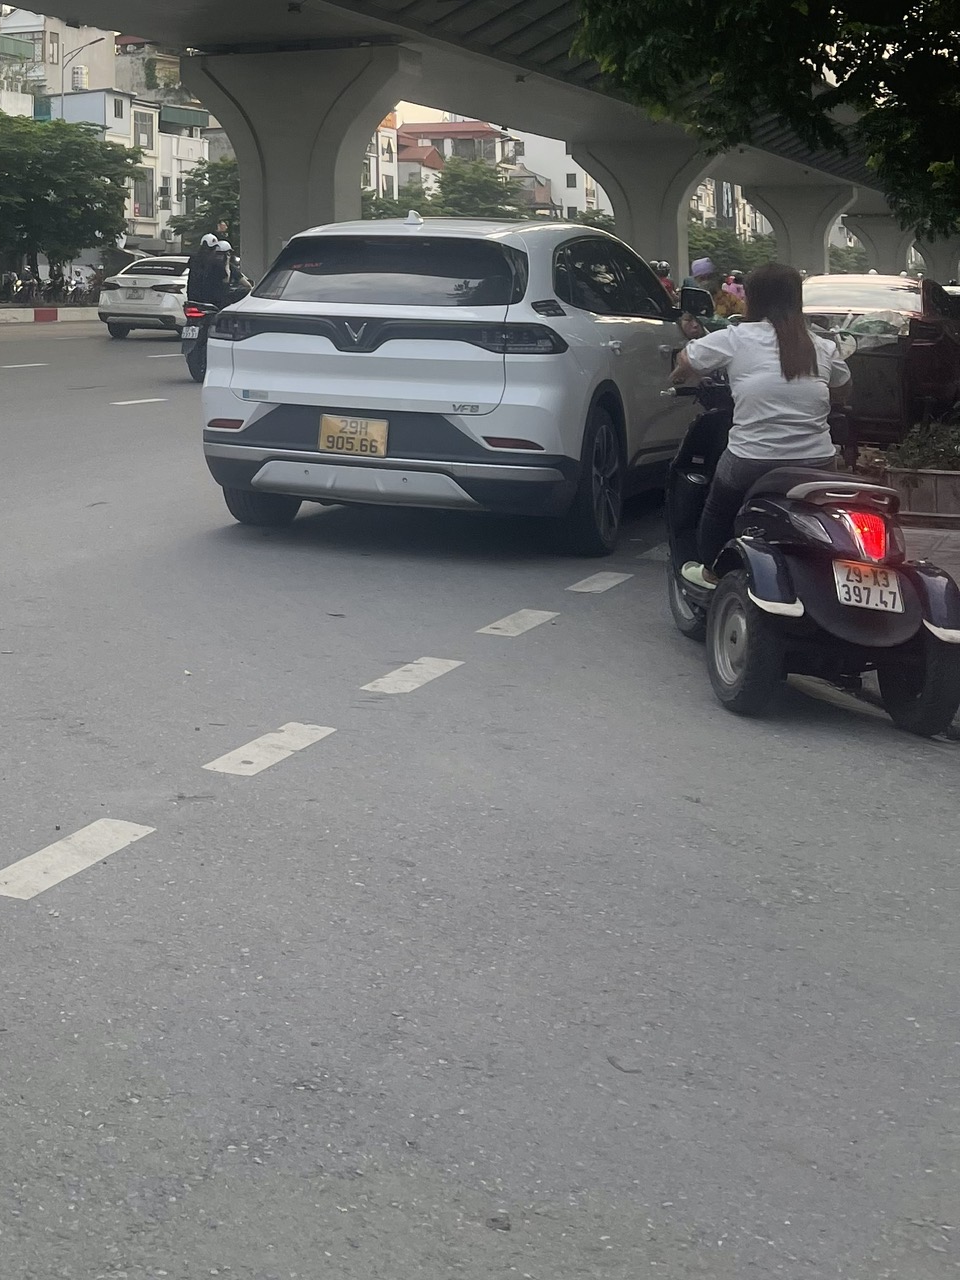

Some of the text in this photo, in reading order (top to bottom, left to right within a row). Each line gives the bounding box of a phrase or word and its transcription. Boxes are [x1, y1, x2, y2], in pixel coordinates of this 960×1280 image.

[339, 419, 369, 436] 29H
[326, 434, 379, 454] 905.66
[842, 584, 897, 609] 397.47
